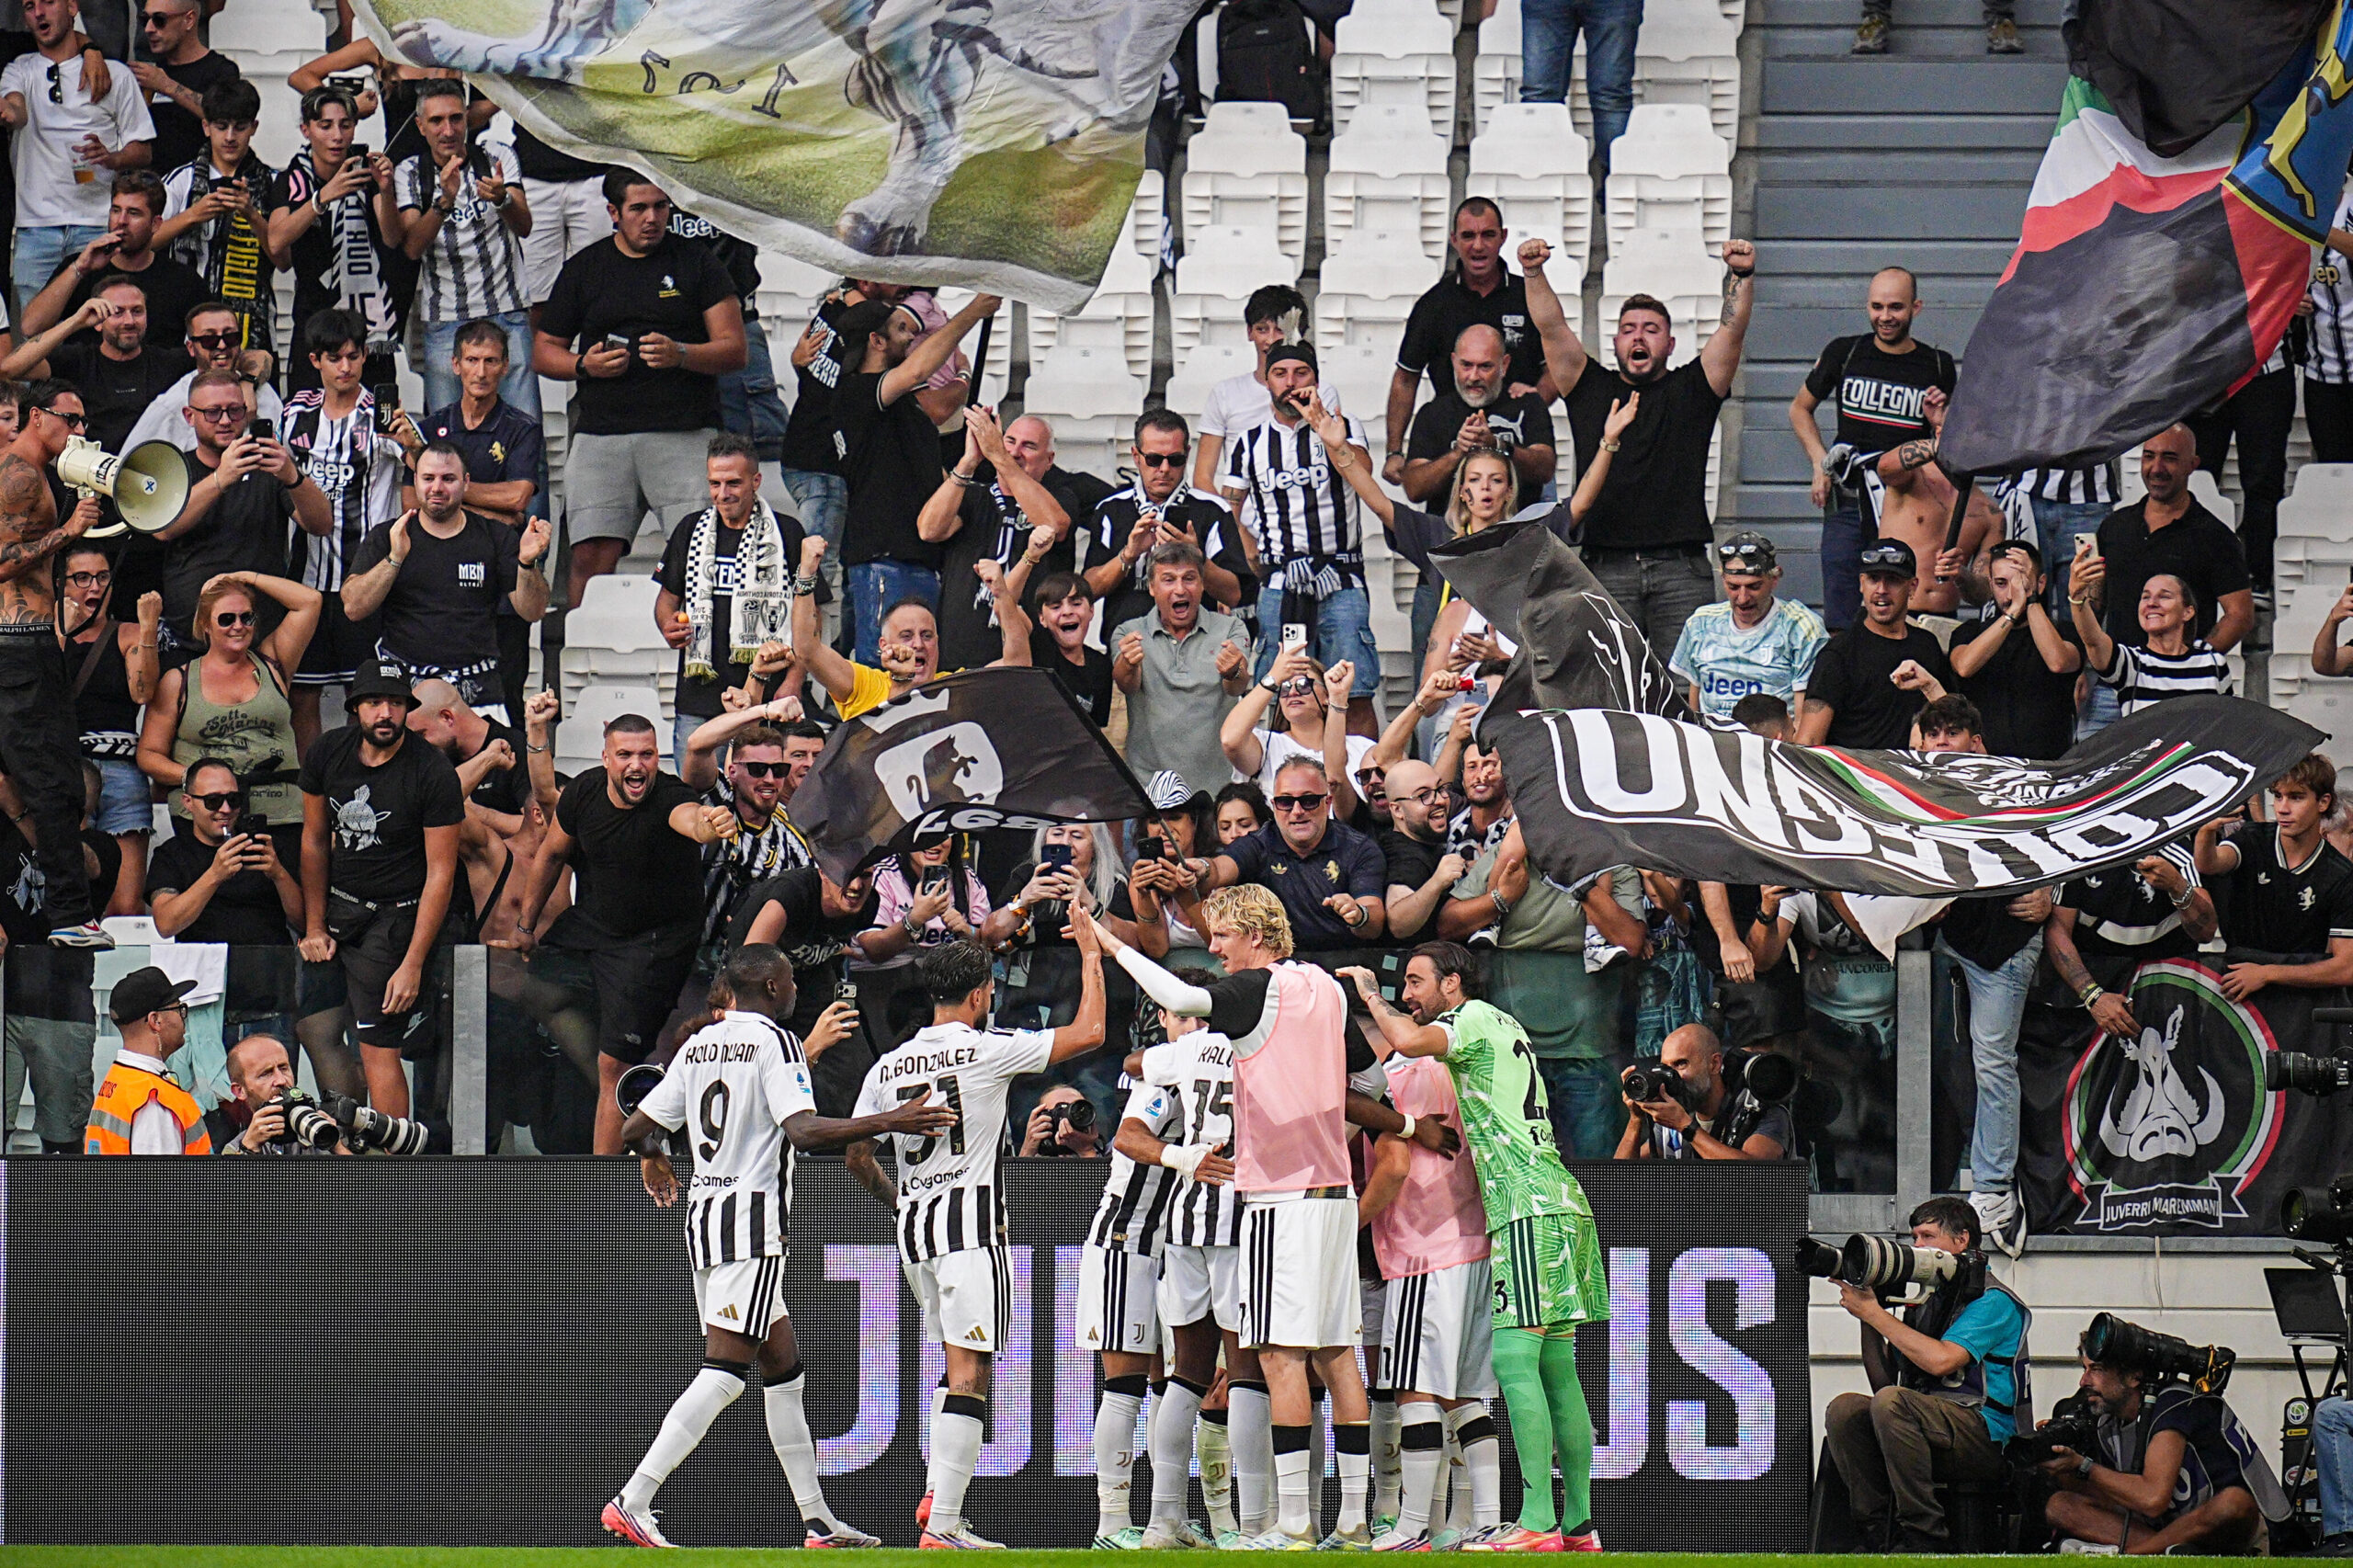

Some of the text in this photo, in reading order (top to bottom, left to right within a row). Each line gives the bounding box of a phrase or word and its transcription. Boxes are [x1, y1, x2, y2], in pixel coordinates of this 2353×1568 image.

[449, 198, 489, 223] eep
[222, 233, 259, 300] FIGLIO
[300, 459, 355, 485] Jeep
[1258, 463, 1330, 494] Jeep
[1704, 672, 1763, 697] Jeep
[250, 789, 282, 798] arino
[913, 808, 1075, 843] 897
[686, 1043, 718, 1065] KOLO
[1199, 1046, 1233, 1068] KALU
[699, 1078, 731, 1164] 9
[1190, 1079, 1233, 1146] 15
[2106, 1197, 2220, 1223] JUVERRI MAREMMANI
